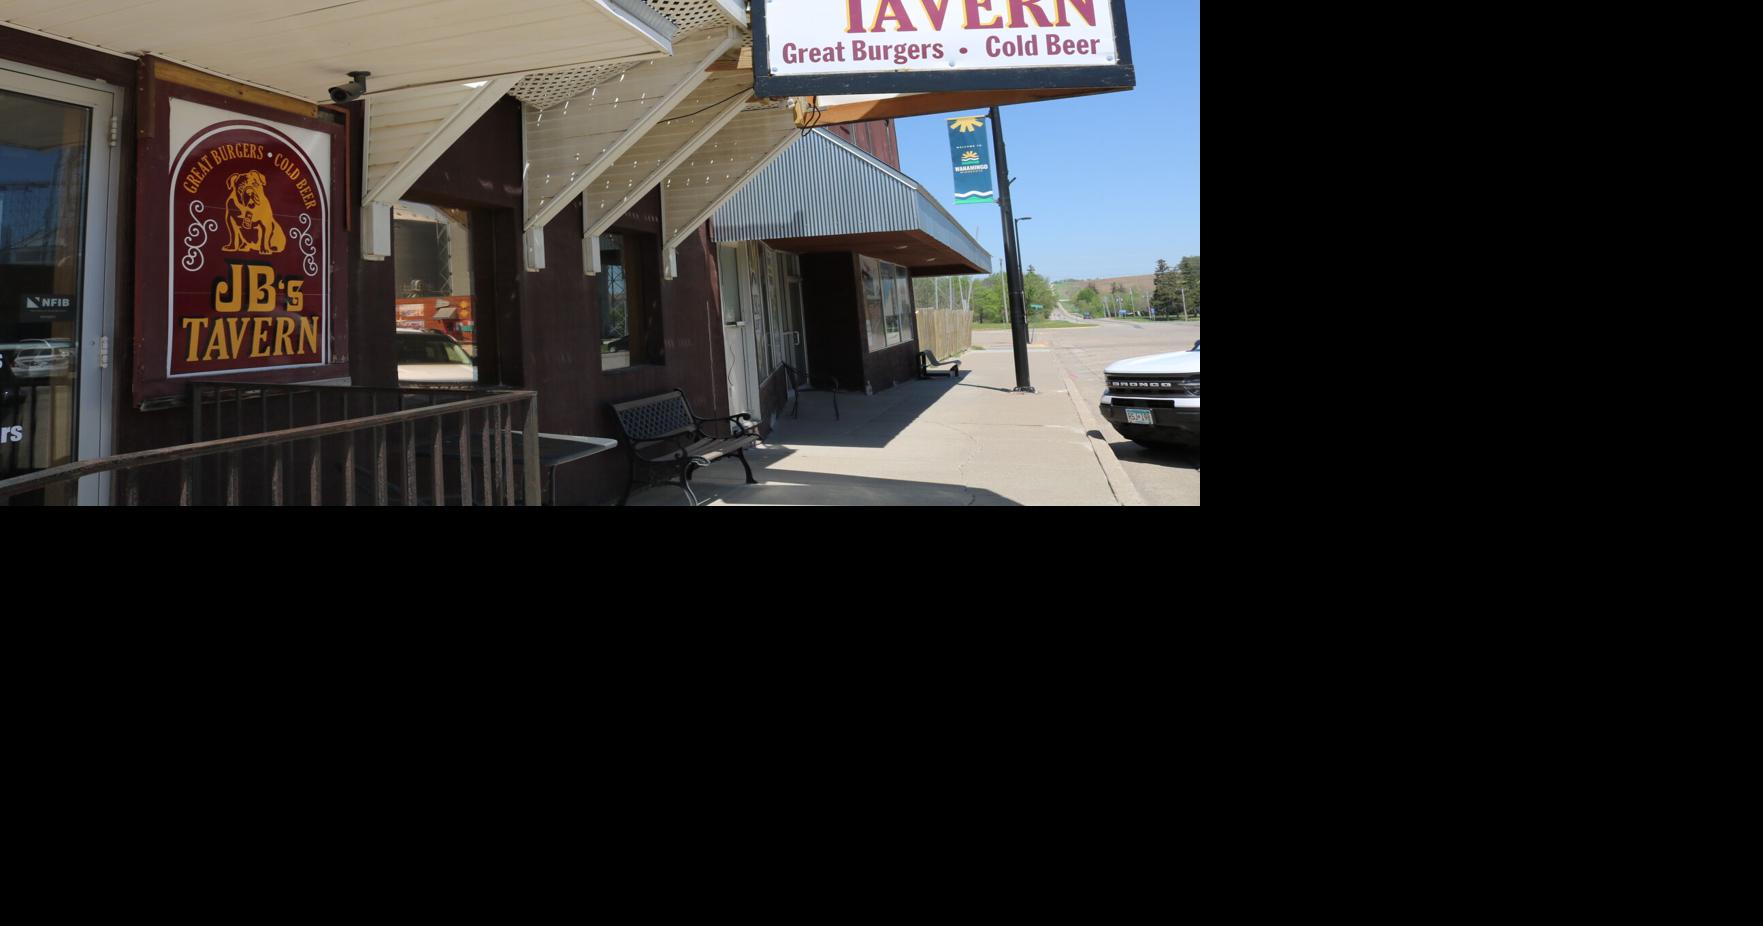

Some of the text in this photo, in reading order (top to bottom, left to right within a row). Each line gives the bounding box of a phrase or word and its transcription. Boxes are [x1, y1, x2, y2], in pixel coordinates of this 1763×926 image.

[782, 33, 1100, 65] Great Burgers Cold Beer
[183, 143, 317, 210] GREAT BURGERS COLD BEER
[42, 298, 70, 307] NFIB
[182, 316, 319, 362] TAVERN
